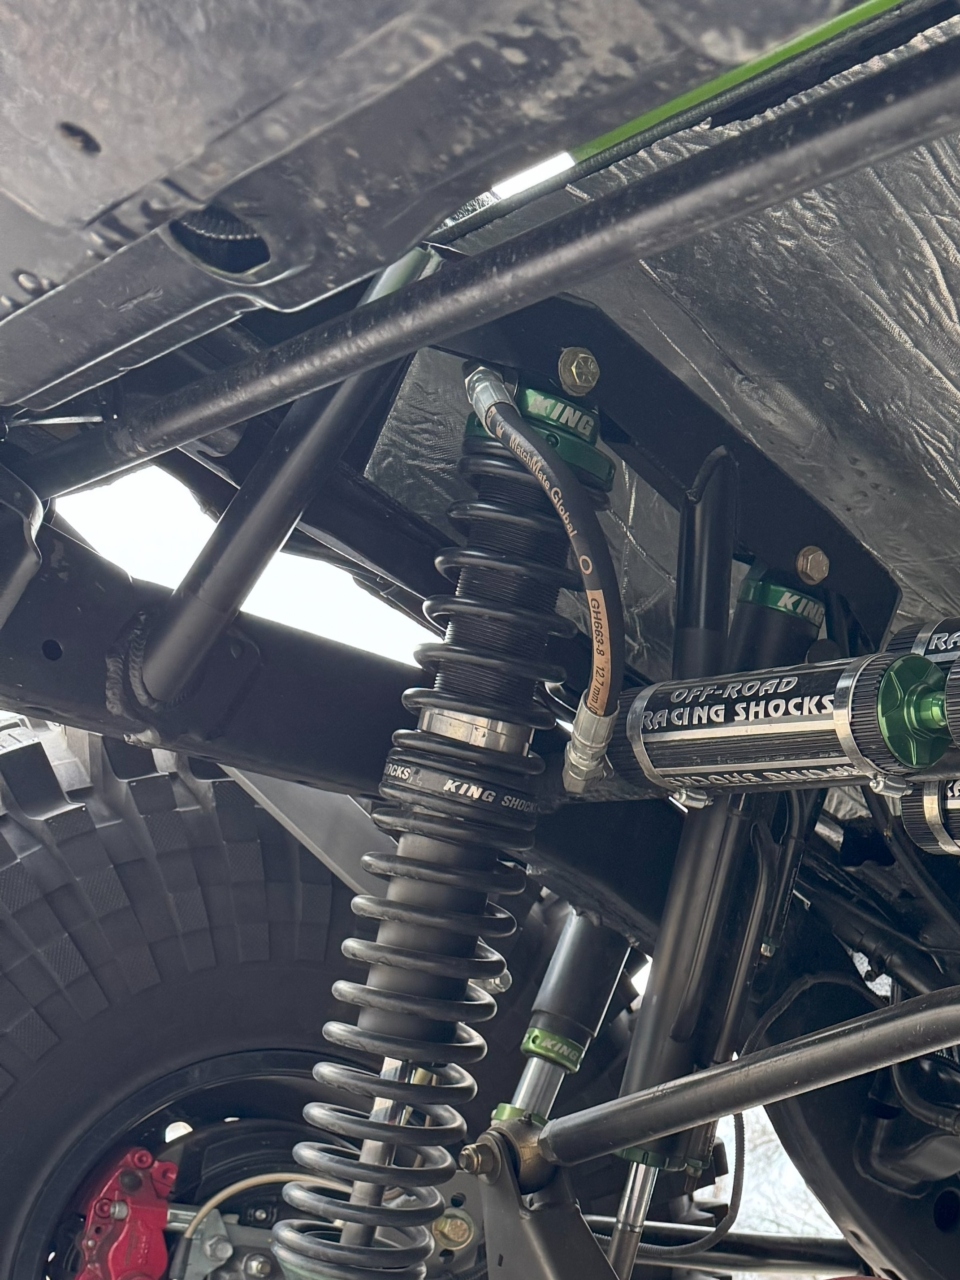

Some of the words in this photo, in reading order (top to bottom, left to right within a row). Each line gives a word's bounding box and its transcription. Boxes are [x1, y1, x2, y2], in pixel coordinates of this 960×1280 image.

[527, 395, 594, 437] KING
[509, 434, 550, 489] MatchMate
[550, 486, 577, 537] Global
[777, 591, 826, 622] KING
[590, 597, 605, 657] GH663-8
[670, 676, 798, 703] OFF-ROAD
[641, 703, 726, 730] RACING
[734, 694, 835, 723] SHOCKS
[443, 779, 497, 803] KING
[541, 1037, 580, 1062] KING
